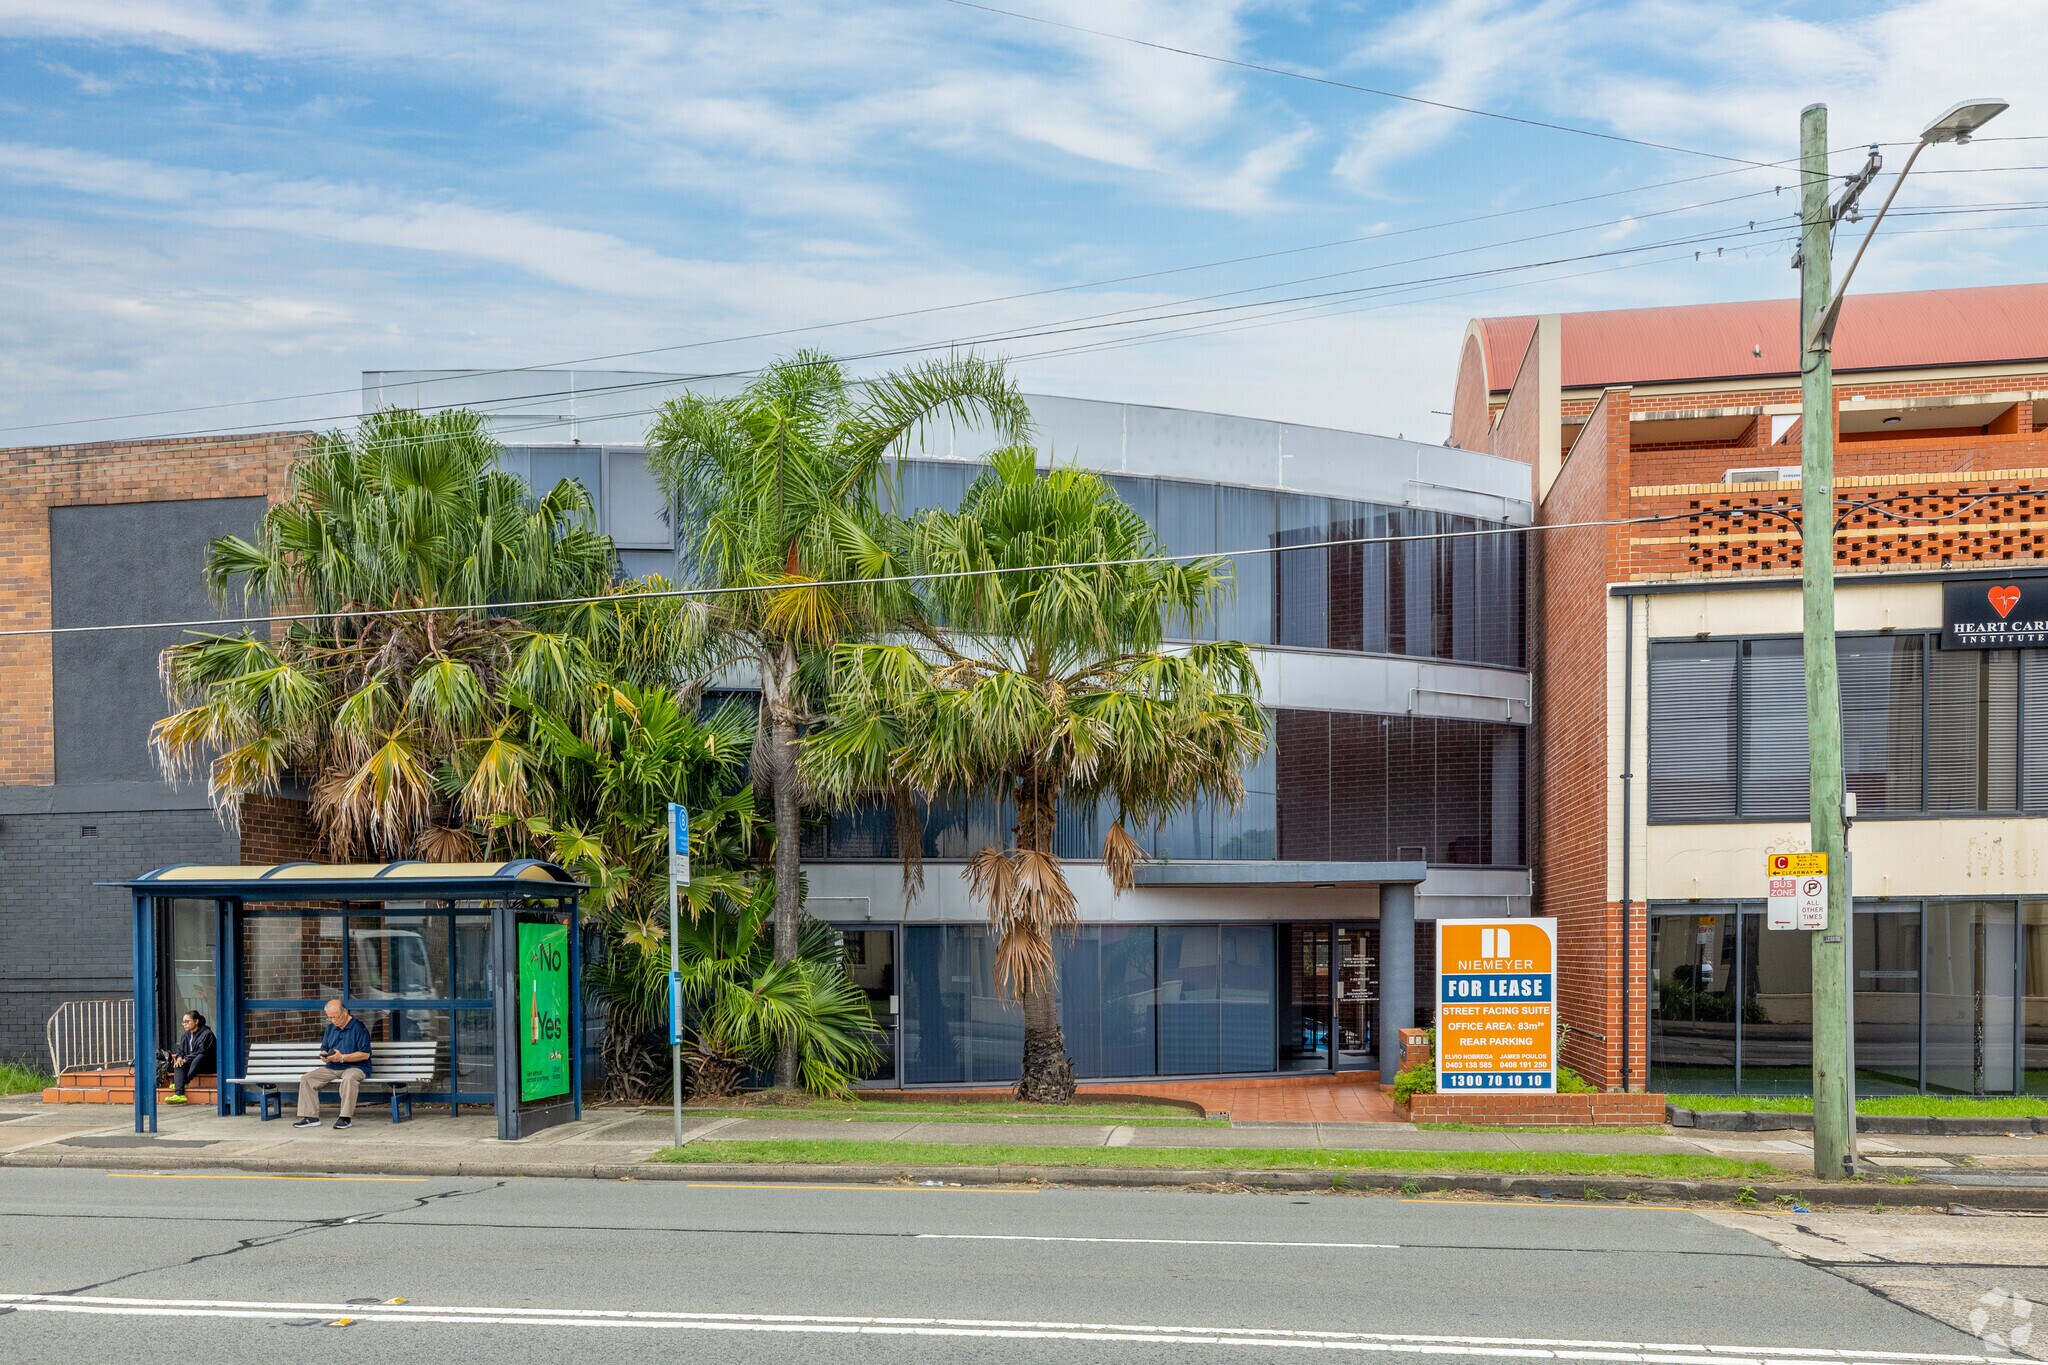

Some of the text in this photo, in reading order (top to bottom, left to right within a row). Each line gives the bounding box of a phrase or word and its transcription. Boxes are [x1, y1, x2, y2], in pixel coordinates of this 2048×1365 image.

[1953, 622, 2008, 633] HEART
[1962, 634, 2045, 644] INSTITUTE
[1777, 857, 1786, 868] C
[1773, 880, 1793, 888] BUS
[1771, 889, 1796, 897] ZONE
[539, 943, 561, 972] No
[1458, 959, 1533, 970] NIEMEYER
[1448, 979, 1543, 997] FOR LEASE
[1443, 1006, 1550, 1015] STREET FACING SUITE
[537, 1011, 561, 1040] Yes
[1448, 1022, 1484, 1031] OFFICE
[1485, 1022, 1516, 1031] AREA:
[1460, 1037, 1533, 1046] REAR PARKING
[1451, 1075, 1542, 1086] 1300 70 10 10
